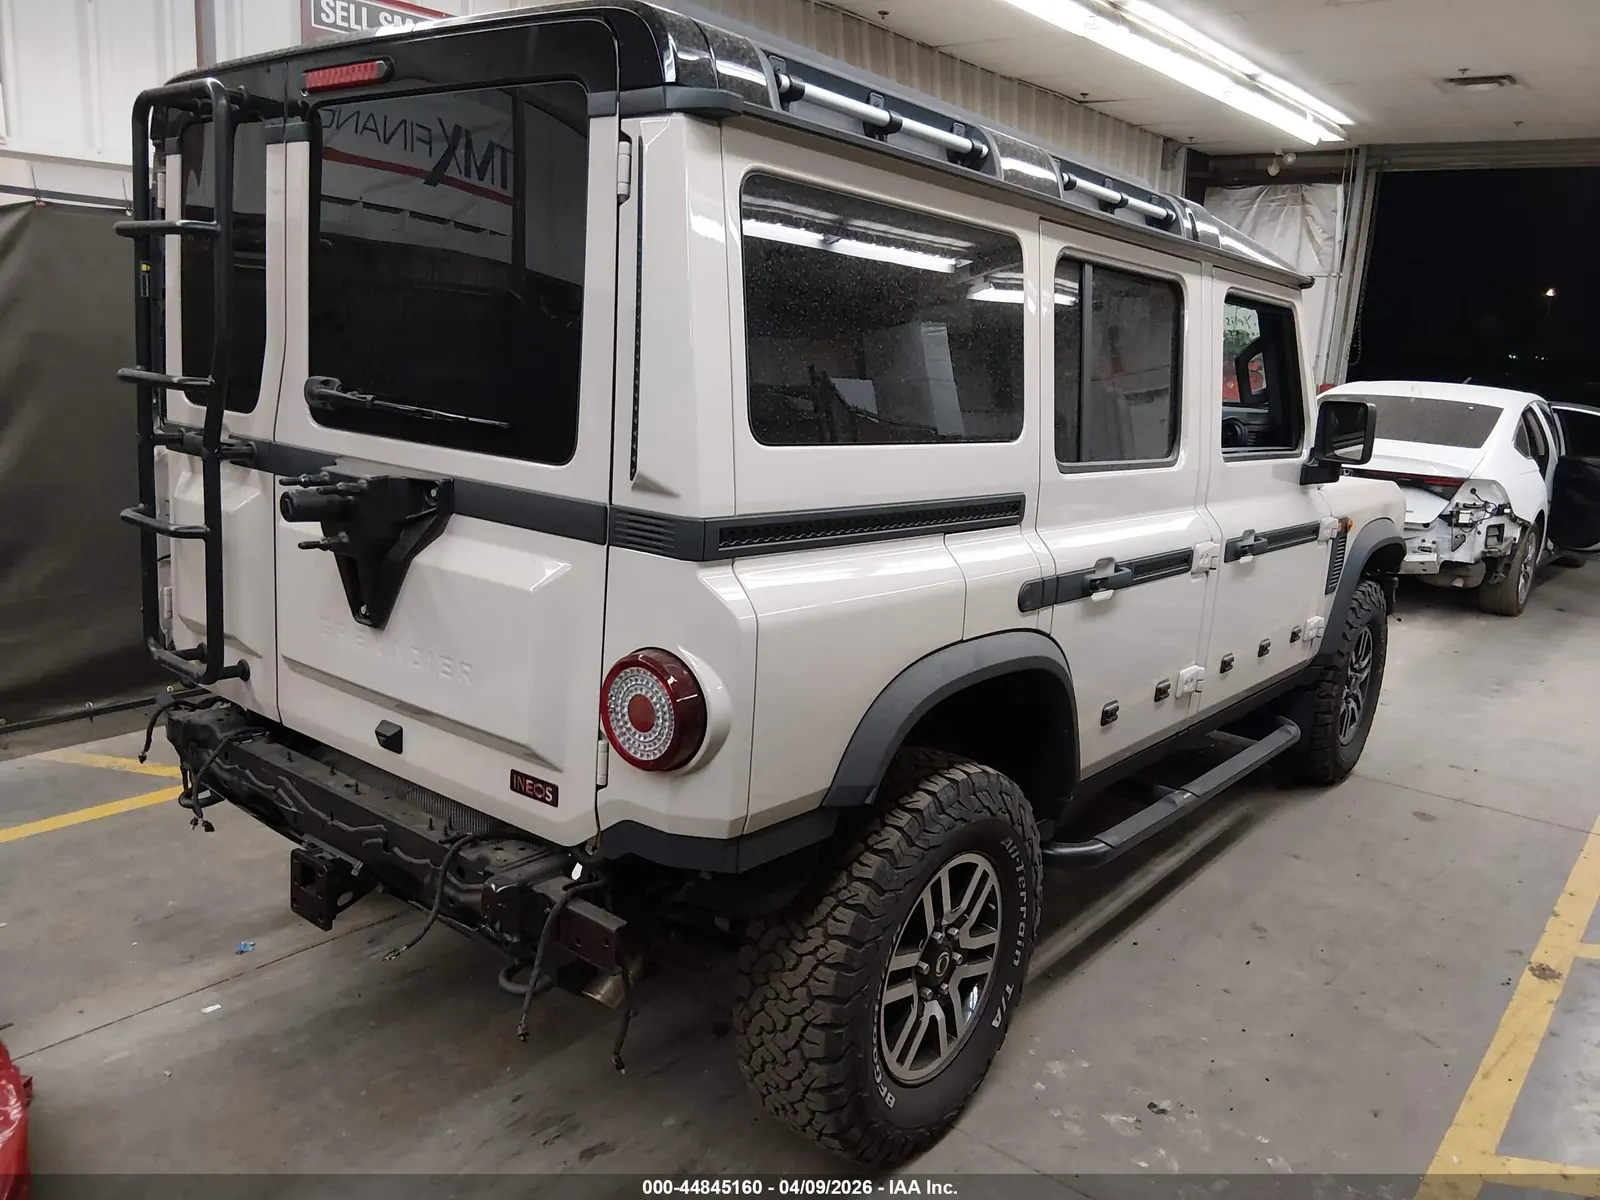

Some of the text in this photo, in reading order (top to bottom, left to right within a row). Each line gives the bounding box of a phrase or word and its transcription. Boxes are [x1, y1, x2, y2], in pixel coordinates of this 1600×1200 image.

[320, 0, 368, 31] SELL
[513, 773, 553, 803] INEOS
[991, 836, 1030, 1028] All-Terrain T/A
